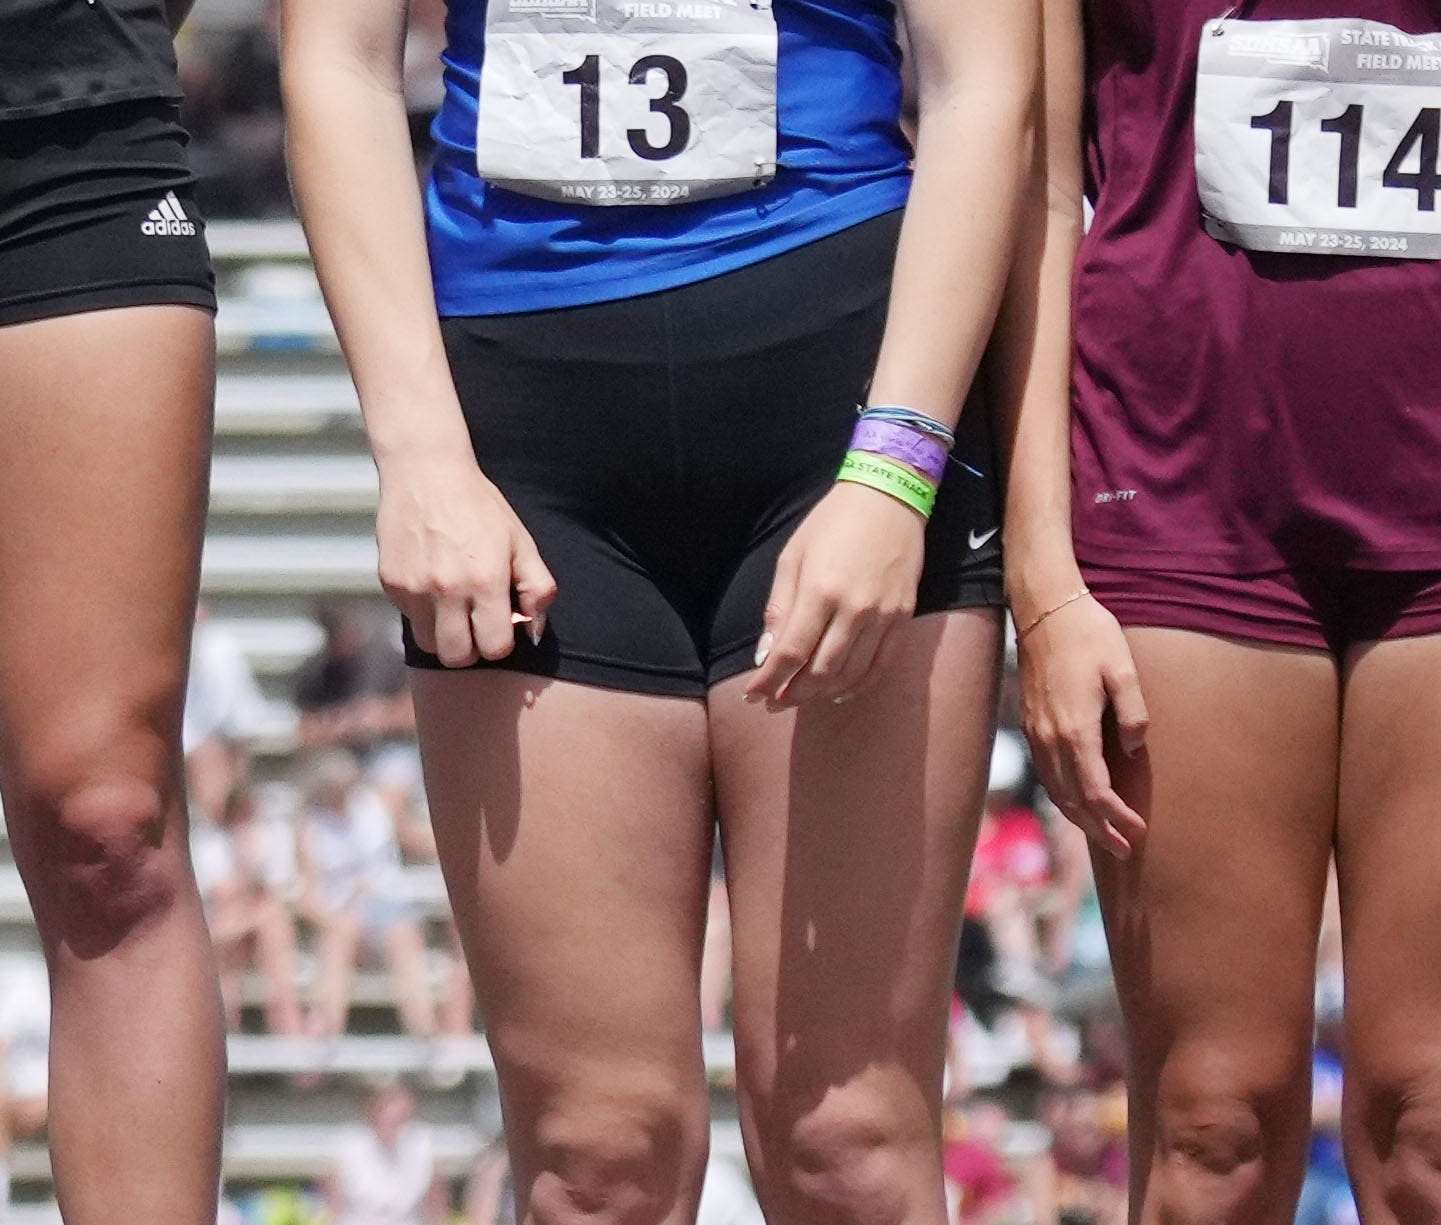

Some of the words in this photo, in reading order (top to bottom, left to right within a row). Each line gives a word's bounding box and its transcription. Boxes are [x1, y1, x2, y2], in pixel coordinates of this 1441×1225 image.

[623, 3, 672, 18] FIELD
[677, 5, 722, 19] MEET
[1341, 29, 1391, 47] STATE
[1356, 53, 1403, 70] FIELD
[562, 53, 691, 161] 13
[561, 185, 595, 199] MAY
[598, 184, 647, 200] 23-25,
[651, 185, 689, 199] 2024
[141, 219, 196, 236] adidas
[1279, 231, 1317, 246] MAY
[1320, 233, 1366, 251] 23-25,
[1369, 236, 1408, 252] 2024
[857, 462, 893, 480] STATE
